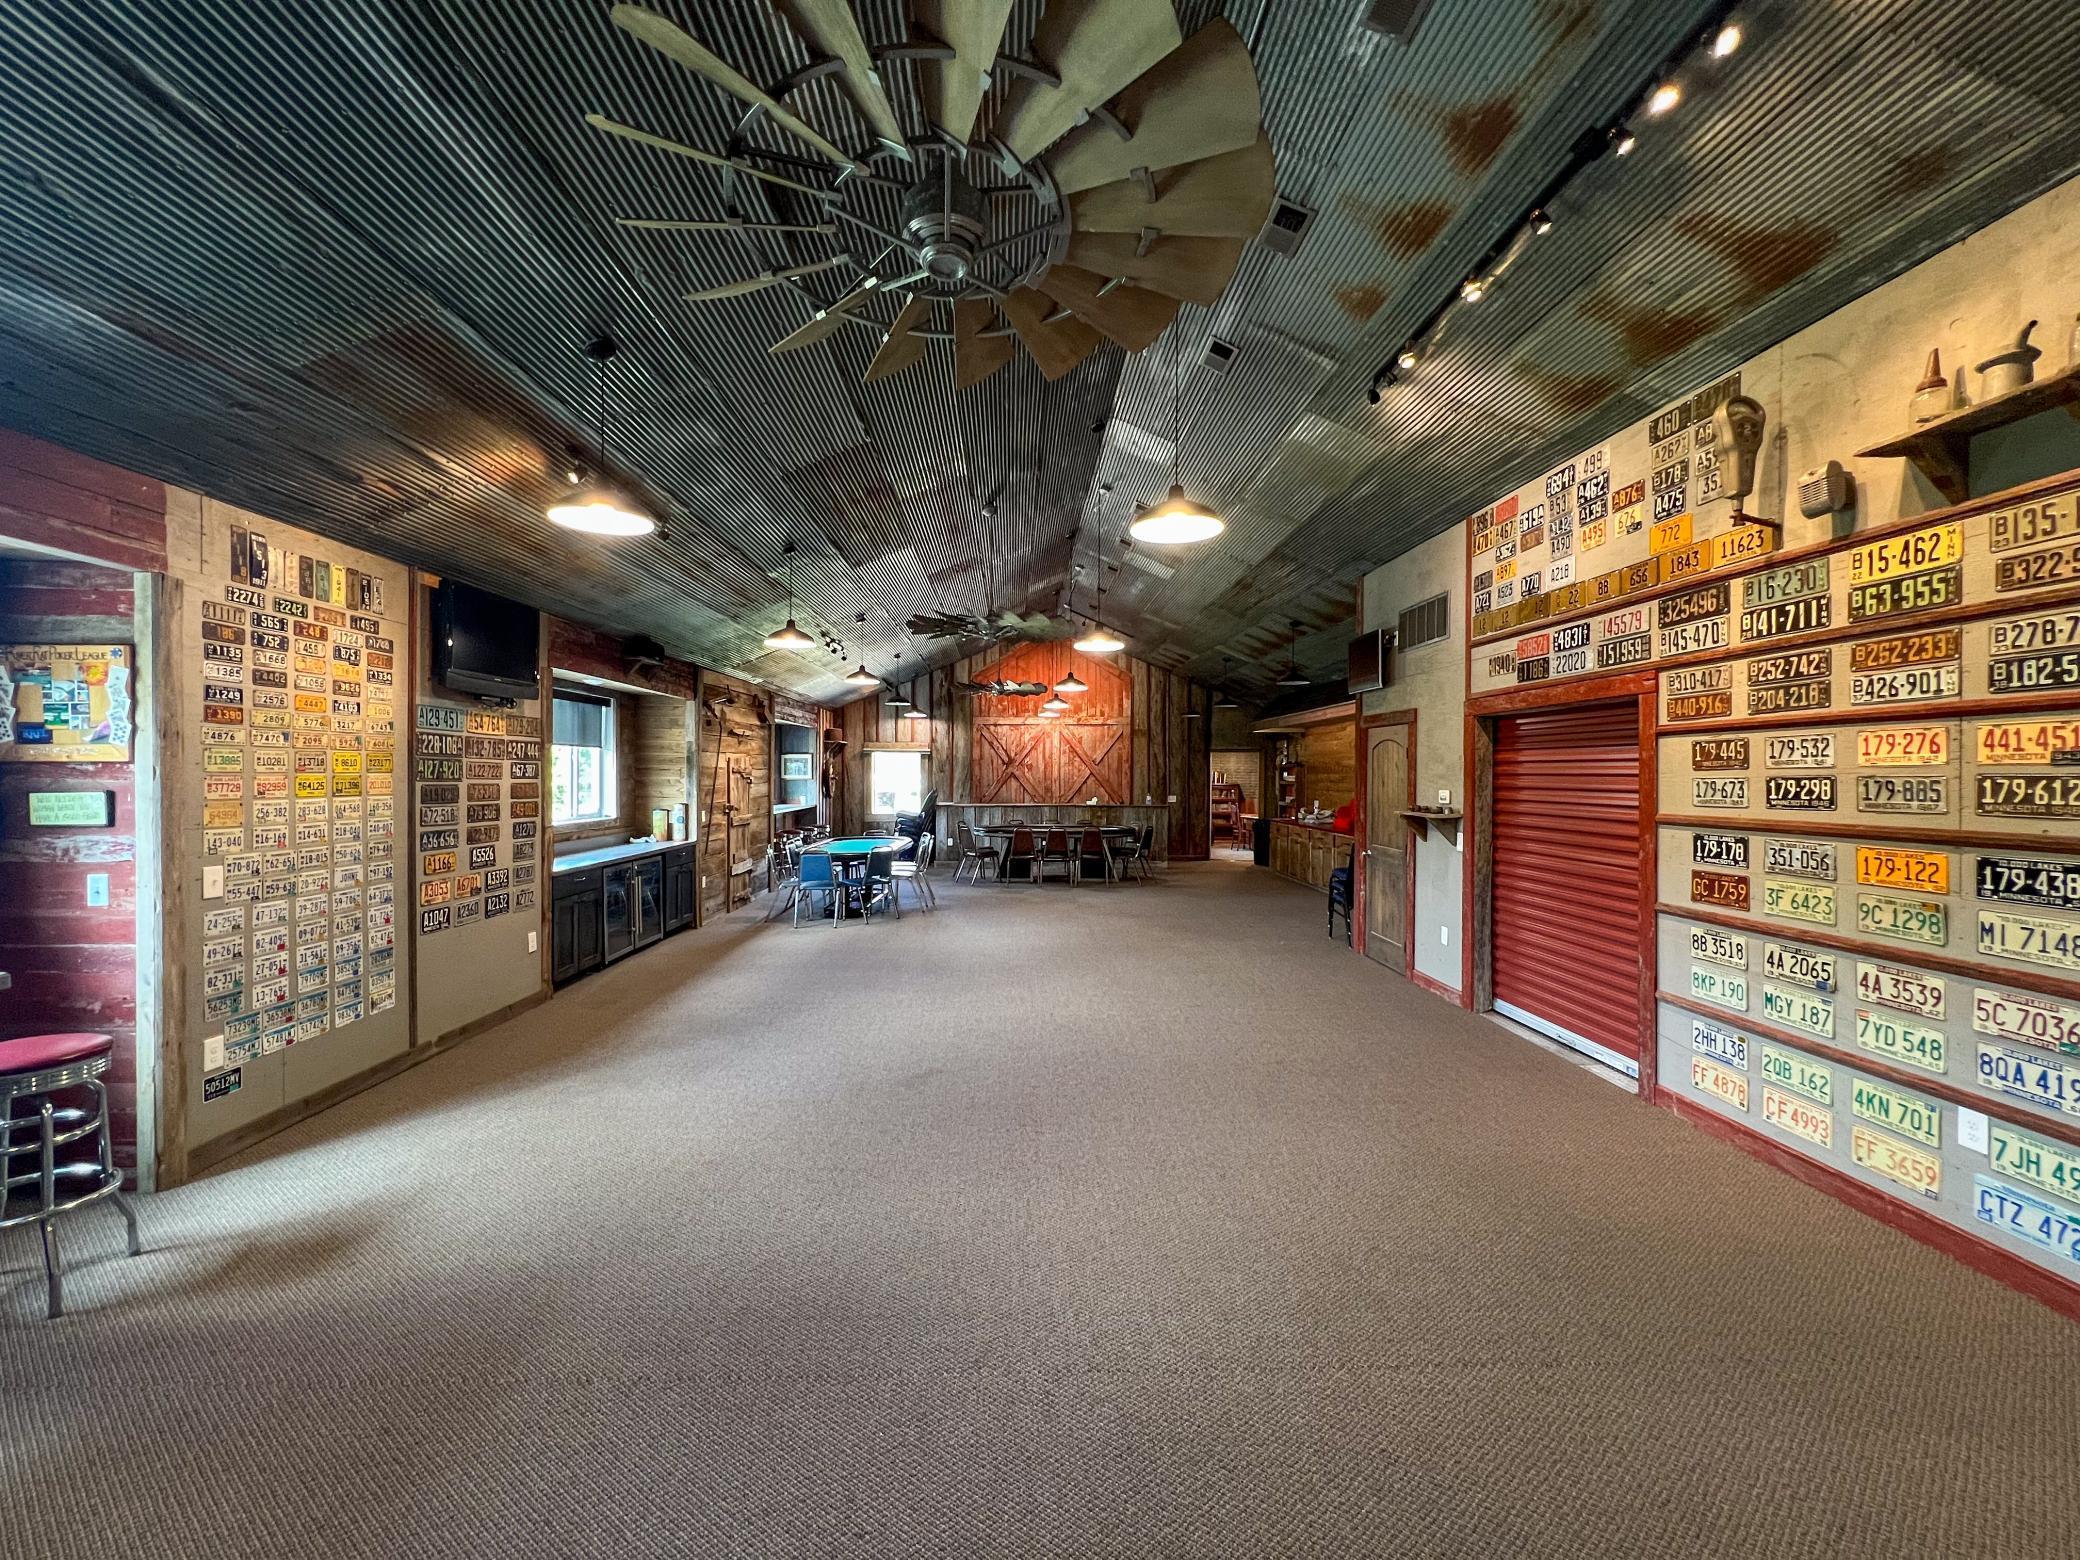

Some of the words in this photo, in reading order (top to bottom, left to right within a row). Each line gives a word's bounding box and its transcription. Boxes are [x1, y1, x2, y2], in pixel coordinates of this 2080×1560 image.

[1583, 450, 1602, 474] 499
[1578, 479, 1603, 498] A462
[1614, 488, 1636, 509] A876
[1655, 494, 1683, 517] A475
[1583, 524, 1603, 544] A495
[1661, 525, 1679, 542] 772
[1721, 530, 1764, 558] 11623
[1552, 535, 1570, 555] A490
[1852, 533, 1940, 576] B15-462
[1671, 552, 1700, 574] 1843
[1630, 568, 1647, 586] 656
[233, 589, 258, 607] 2274
[1569, 589, 1579, 605] 22
[1852, 573, 1945, 615] B63-955
[261, 616, 280, 629] 565
[1603, 610, 1642, 638] 145579
[1743, 599, 1817, 636] B141-711
[263, 634, 280, 648] 752
[1558, 629, 1582, 647] 4831
[1661, 622, 1720, 652] B145-470
[76, 648, 108, 661] LEAGUE
[216, 646, 241, 658] 1135
[1604, 638, 1642, 665] 151959
[216, 666, 241, 677] 1385
[1556, 651, 1586, 674] 22020
[1751, 653, 1819, 681] B252-742
[1669, 669, 1722, 692] B310-417
[1853, 671, 1944, 698] B426-901
[215, 690, 241, 700] 1249
[263, 695, 285, 704] 2576
[1750, 685, 1819, 709] B204-218
[217, 709, 242, 720] 1390
[264, 715, 285, 724] 2809
[337, 721, 355, 729] 3217
[419, 709, 460, 729] A129-451
[210, 731, 236, 740] 4876
[1862, 733, 1941, 756] 179-276
[1695, 742, 1744, 760] 179-445
[1769, 737, 1830, 760] 179-532
[1986, 752, 2047, 760] MINNESOTA
[261, 758, 286, 766] 10281
[419, 762, 460, 779] A127-920
[212, 783, 241, 792] 37728
[1696, 781, 1744, 799] 179-673
[1769, 779, 1831, 800] 179-298
[1862, 780, 1941, 802] 179-885
[1982, 779, 2080, 805] 179-612
[256, 807, 287, 818] 256-382
[1984, 805, 2046, 813] MINNESOTA
[422, 830, 455, 845] A36-656
[472, 847, 495, 862] A5526
[1696, 840, 1744, 861] 179-178
[1769, 847, 1830, 871] 351-056
[427, 855, 452, 870] A1166
[1863, 856, 1939, 884] 179-122
[2031, 861, 2063, 870] LAKES
[487, 870, 508, 884] A3392
[1984, 867, 2080, 899] 179-438
[424, 882, 449, 899] A3053
[1693, 878, 1708, 896] GC
[1713, 881, 1747, 901] 1759
[2000, 892, 2063, 905] MINNESOTA
[487, 894, 508, 910] A2132
[1766, 887, 1785, 907] 3F
[1790, 892, 1833, 915] 6423
[207, 919, 237, 931] 24-255
[256, 908, 282, 922] 47-132
[424, 907, 449, 928] A1047
[1859, 903, 1882, 924] 9C
[1891, 908, 1941, 934] 1298
[256, 935, 282, 949] 82-409
[1692, 933, 1707, 953] 8B
[1712, 938, 1744, 960] 3518
[1766, 950, 1785, 970] 4A
[1790, 955, 1832, 982] 2065
[256, 989, 282, 1002] 13-769
[1692, 972, 1716, 992] 8KP
[1720, 981, 1744, 1001] 190
[1859, 973, 1883, 996] 4A
[1890, 977, 1942, 1009] 3539
[1764, 990, 1793, 1016] MGY
[1800, 1002, 1831, 1028] 187
[1976, 998, 2007, 1026] 5C
[2016, 1011, 2080, 1045] 7036
[1694, 1027, 1717, 1050] 2HH
[1721, 1038, 1745, 1062] 138
[1859, 1019, 1896, 1047] 7YD
[1902, 1029, 1943, 1061] 548
[1980, 1053, 2025, 1088] 8QA
[1799, 1068, 1829, 1095] 162
[1766, 1096, 1788, 1119] CF
[1790, 1107, 1829, 1140] 4993
[1855, 1088, 1890, 1119] 4KN
[1900, 1102, 1936, 1137] 701
[1993, 1137, 2041, 1177] 7JH
[1887, 1153, 1937, 1186] 3659
[1980, 1189, 2024, 1227] CTZ
